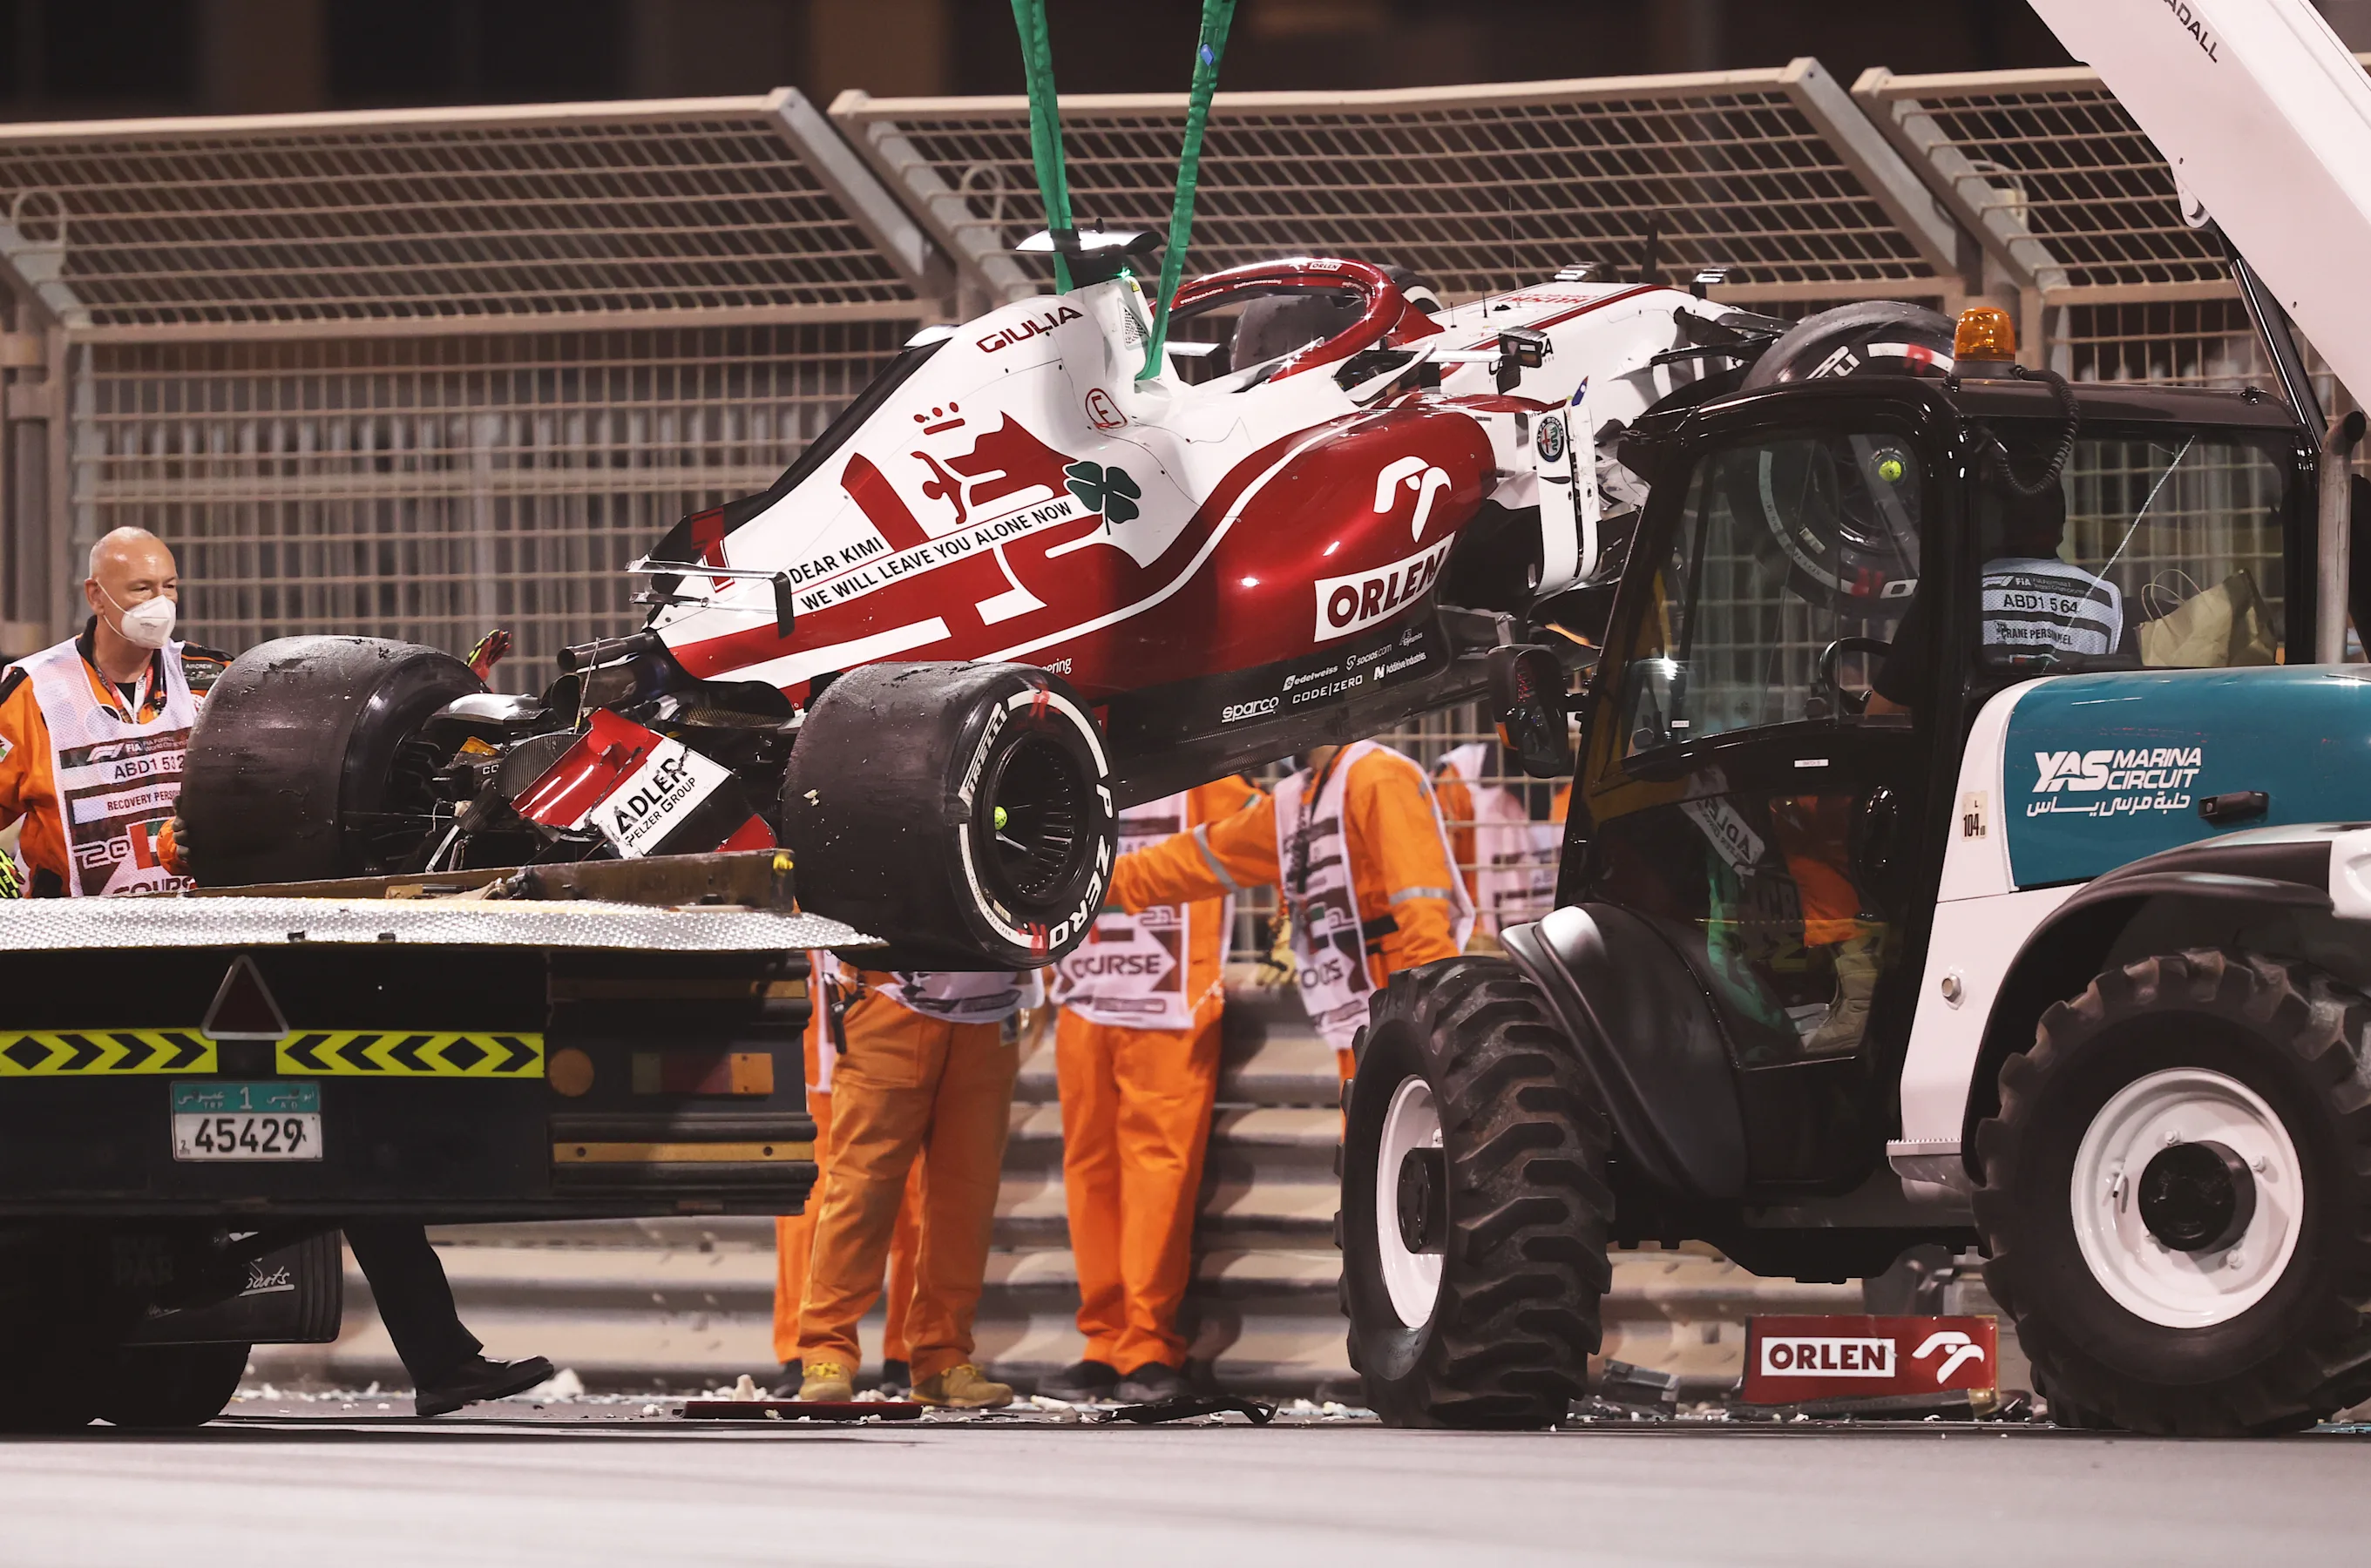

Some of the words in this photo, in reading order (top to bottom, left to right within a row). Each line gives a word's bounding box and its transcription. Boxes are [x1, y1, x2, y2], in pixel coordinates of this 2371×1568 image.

[976, 307, 1083, 353] GIULIA
[1091, 395, 1121, 425] E
[789, 554, 840, 585] DEAR
[839, 536, 884, 564] KIMI
[801, 589, 832, 611] WE
[832, 569, 878, 598] WILL
[877, 549, 935, 579] LEAVE
[933, 536, 971, 559] YOU
[977, 514, 1032, 546] ALONE
[1031, 501, 1073, 526] NOW
[1327, 545, 1446, 628] ORLEN
[2015, 577, 2032, 586] FIA
[2003, 594, 2044, 609] ABD1
[2001, 628, 2028, 639] CRANE
[1357, 643, 1392, 666] socios.com
[1386, 659, 1405, 675] Additive
[1405, 652, 1426, 668] Industries
[1295, 665, 1338, 686] edelweiss
[1221, 696, 1279, 723] sparco
[125, 742, 141, 753] FIA
[114, 758, 158, 780] ABD1
[2032, 750, 2115, 793] YAS
[2112, 747, 2202, 769] MARINA
[2106, 768, 2200, 790] CIRCUIT
[107, 793, 152, 811] RECOVERY
[613, 757, 688, 835] ADLER
[1096, 784, 1114, 818] P
[626, 811, 662, 848] PELZER
[661, 777, 696, 814] GROUP
[1963, 813, 1980, 837] 104
[1049, 835, 1112, 950] ZERO
[240, 1086, 253, 1110] 1
[195, 1118, 303, 1153] 45429
[1769, 1342, 1886, 1370] ORLEN
